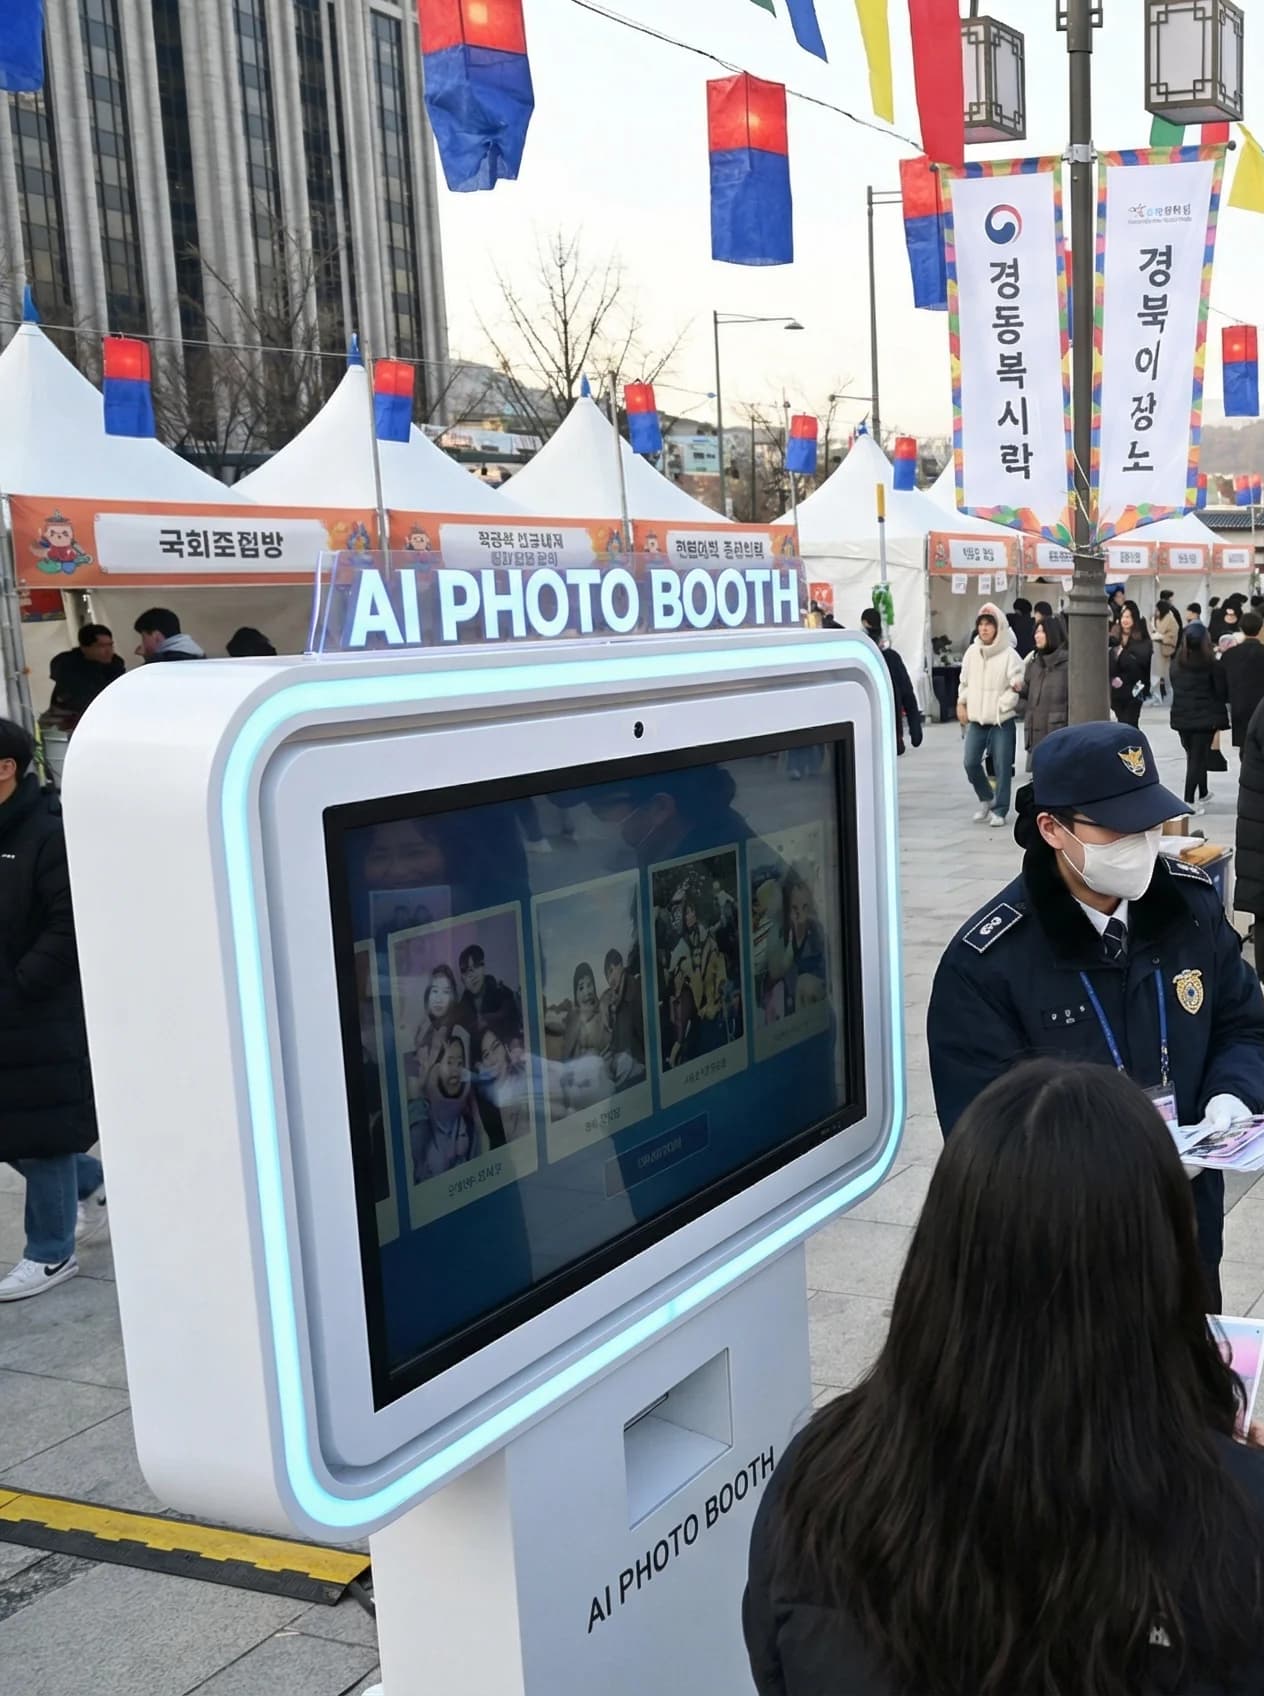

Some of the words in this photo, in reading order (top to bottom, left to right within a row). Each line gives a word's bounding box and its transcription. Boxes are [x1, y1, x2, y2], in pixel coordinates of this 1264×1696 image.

[1122, 244, 1173, 472] 경북이장노
[348, 568, 422, 646] AI
[438, 567, 640, 643] PHOTO
[651, 567, 800, 631] BOOTH
[588, 1585, 612, 1634] AI
[619, 1513, 699, 1605] PHOTO
[705, 1445, 775, 1529] BOOTH
